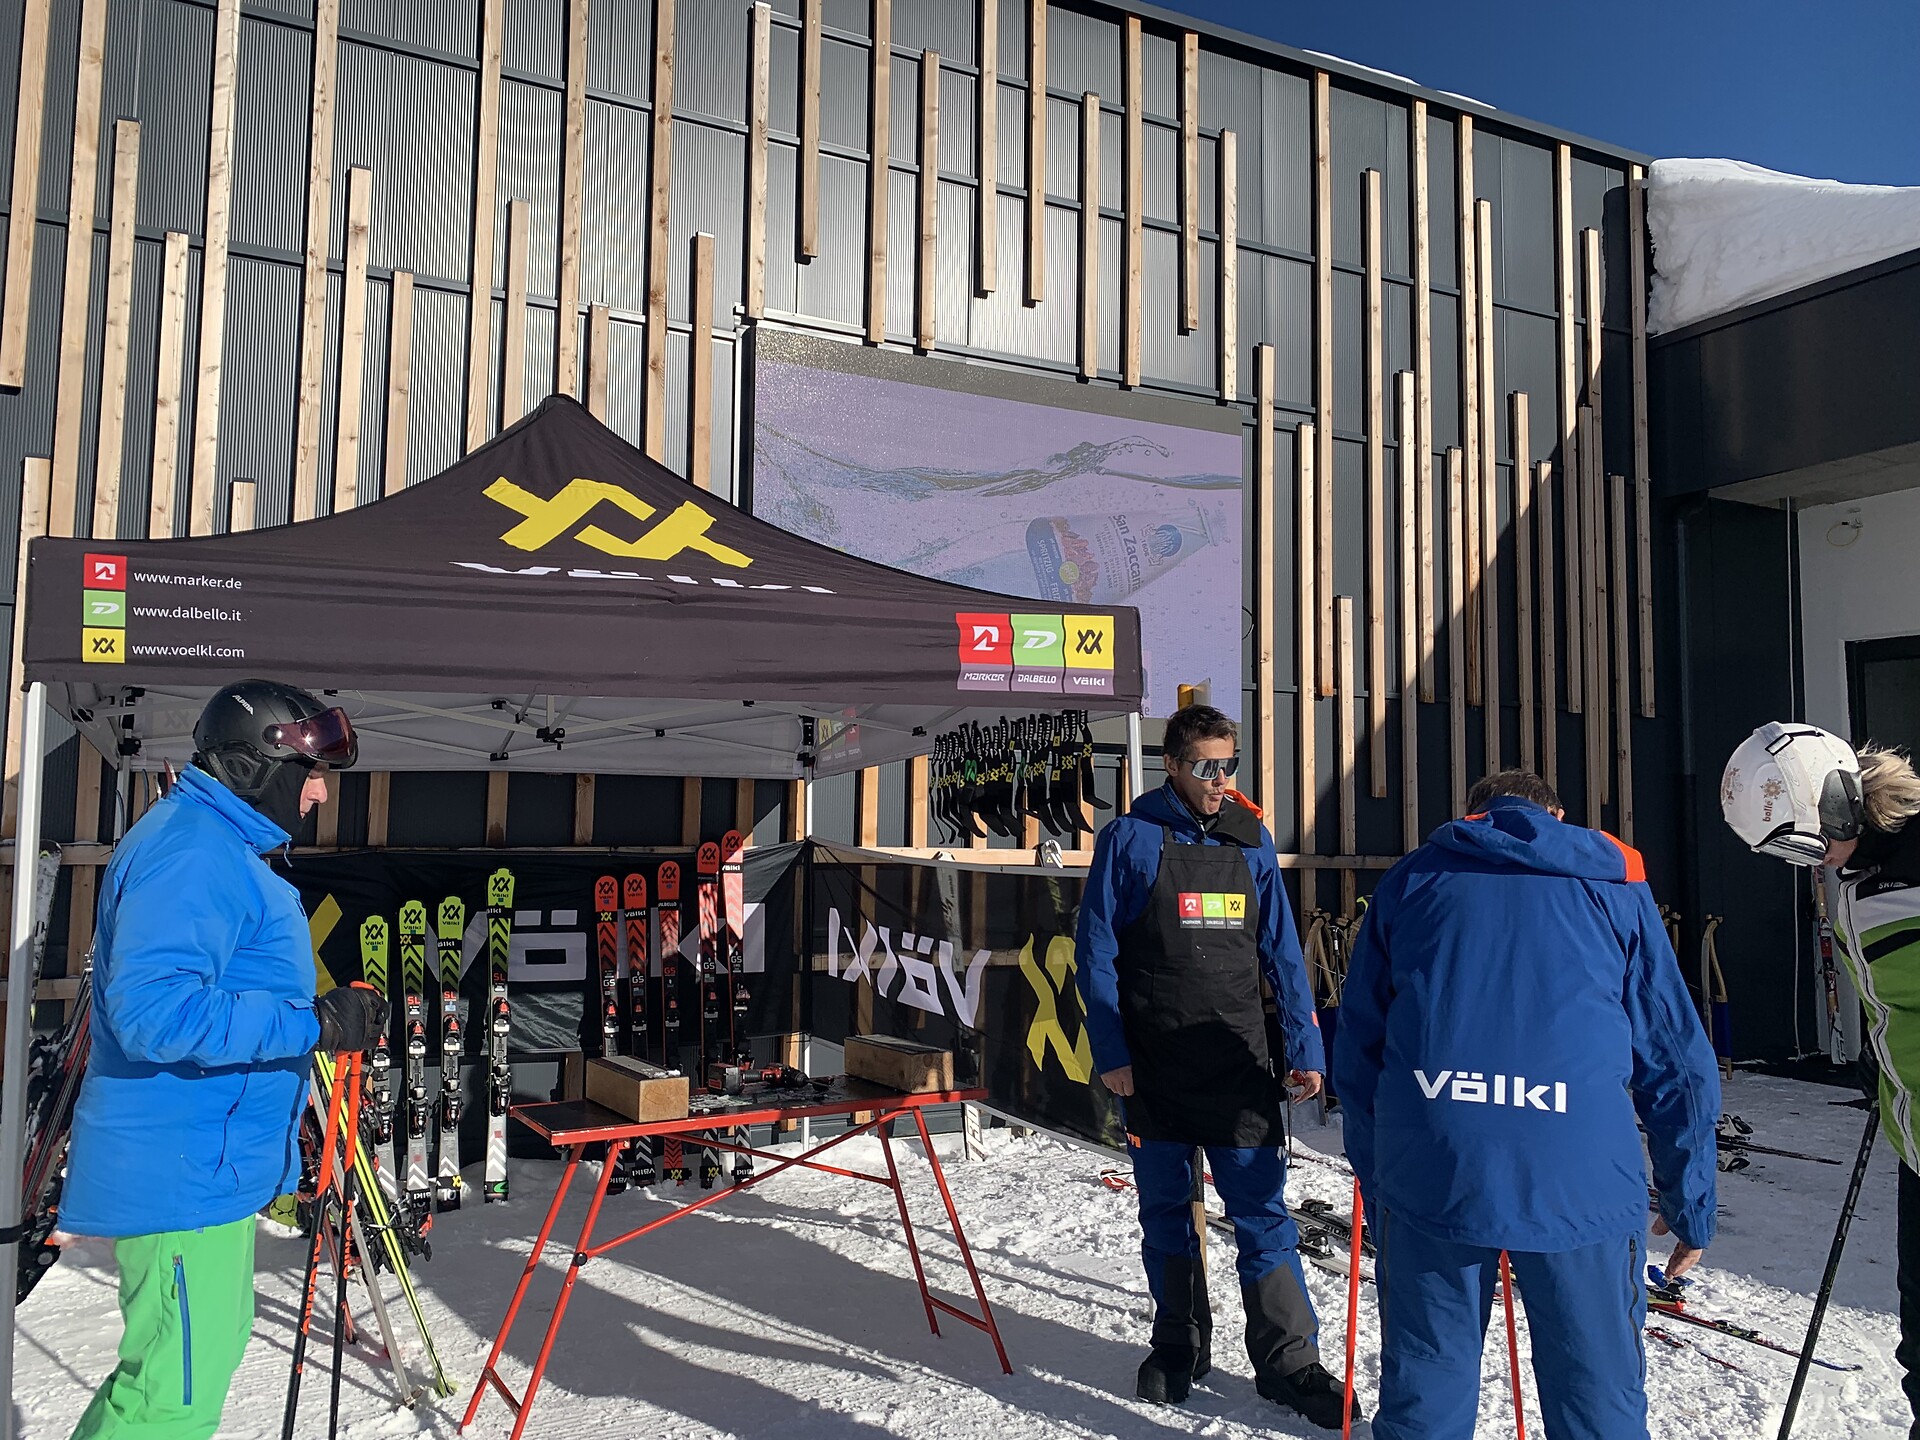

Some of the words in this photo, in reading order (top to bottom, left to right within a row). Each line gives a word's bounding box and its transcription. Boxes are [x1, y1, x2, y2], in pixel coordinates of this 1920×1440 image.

[1113, 514, 1130, 535] San
[1123, 536, 1145, 592] Zaccaria
[133, 571, 242, 589] www.marker.de
[132, 605, 242, 622] www.dalbello.it
[132, 643, 245, 659] www.voelkl.com
[963, 672, 1005, 682] MARKER
[1017, 674, 1057, 684] DALBELLO
[232, 694, 254, 716] ALPINA
[703, 962, 715, 970] GS
[731, 955, 742, 964] GS
[603, 979, 616, 987] GS
[407, 996, 421, 1004] SL
[444, 991, 456, 999] SL
[1413, 1069, 1567, 1114] Völkl
